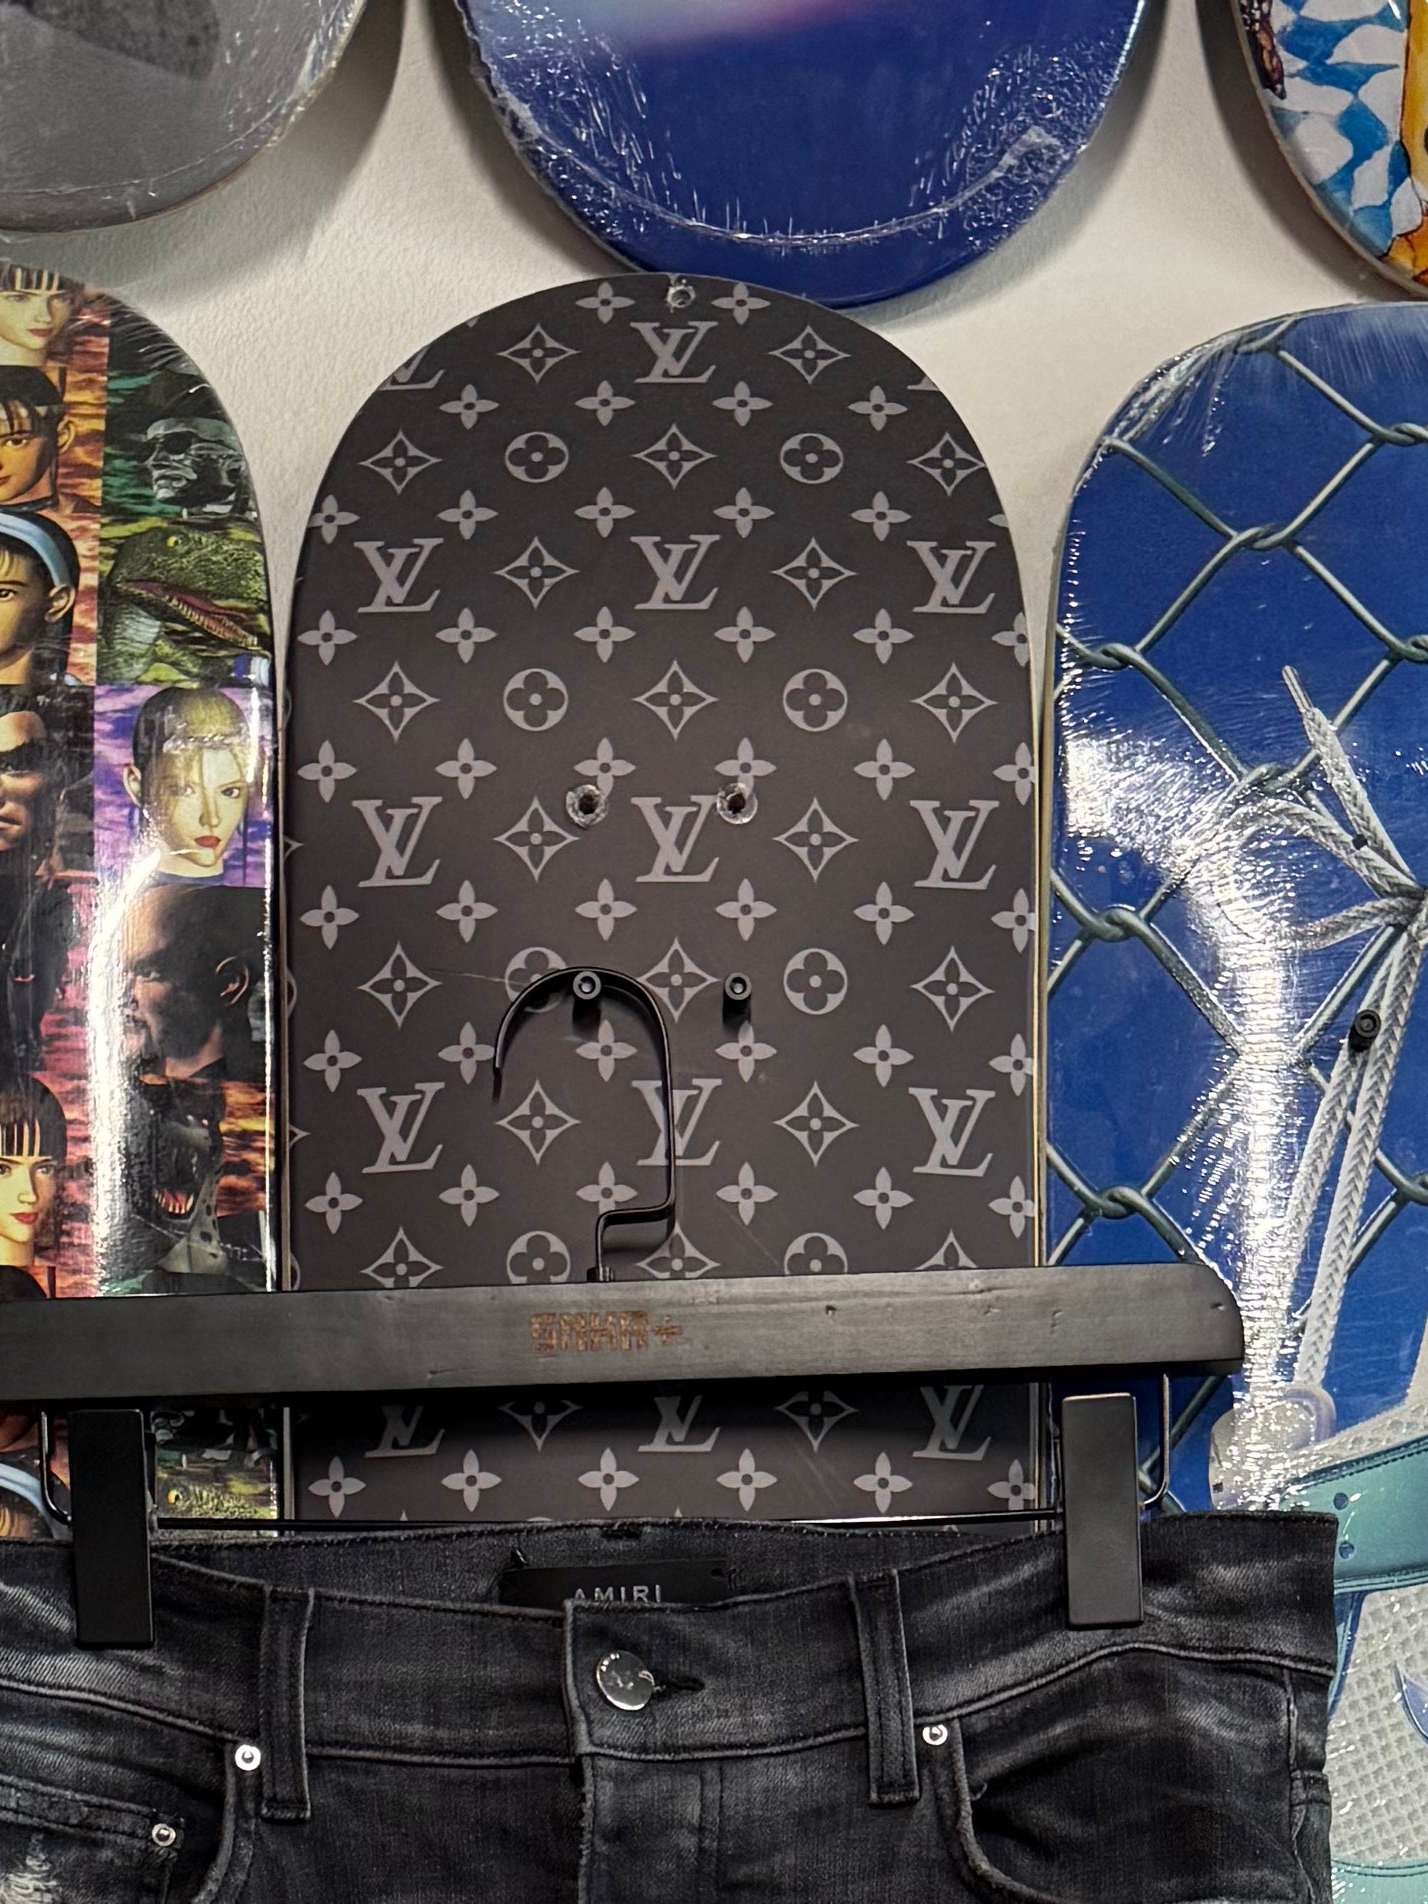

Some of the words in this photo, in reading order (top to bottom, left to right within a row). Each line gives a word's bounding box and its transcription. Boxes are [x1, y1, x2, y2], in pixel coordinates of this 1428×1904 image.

[354, 537, 444, 614] LV
[630, 534, 722, 610] LV
[906, 540, 997, 614] LV
[352, 796, 442, 889] LV
[630, 796, 721, 883] LV
[909, 800, 1000, 890] LV
[357, 1081, 444, 1174] LV
[907, 1087, 996, 1177] LV
[575, 1584, 661, 1603] AMIRI
